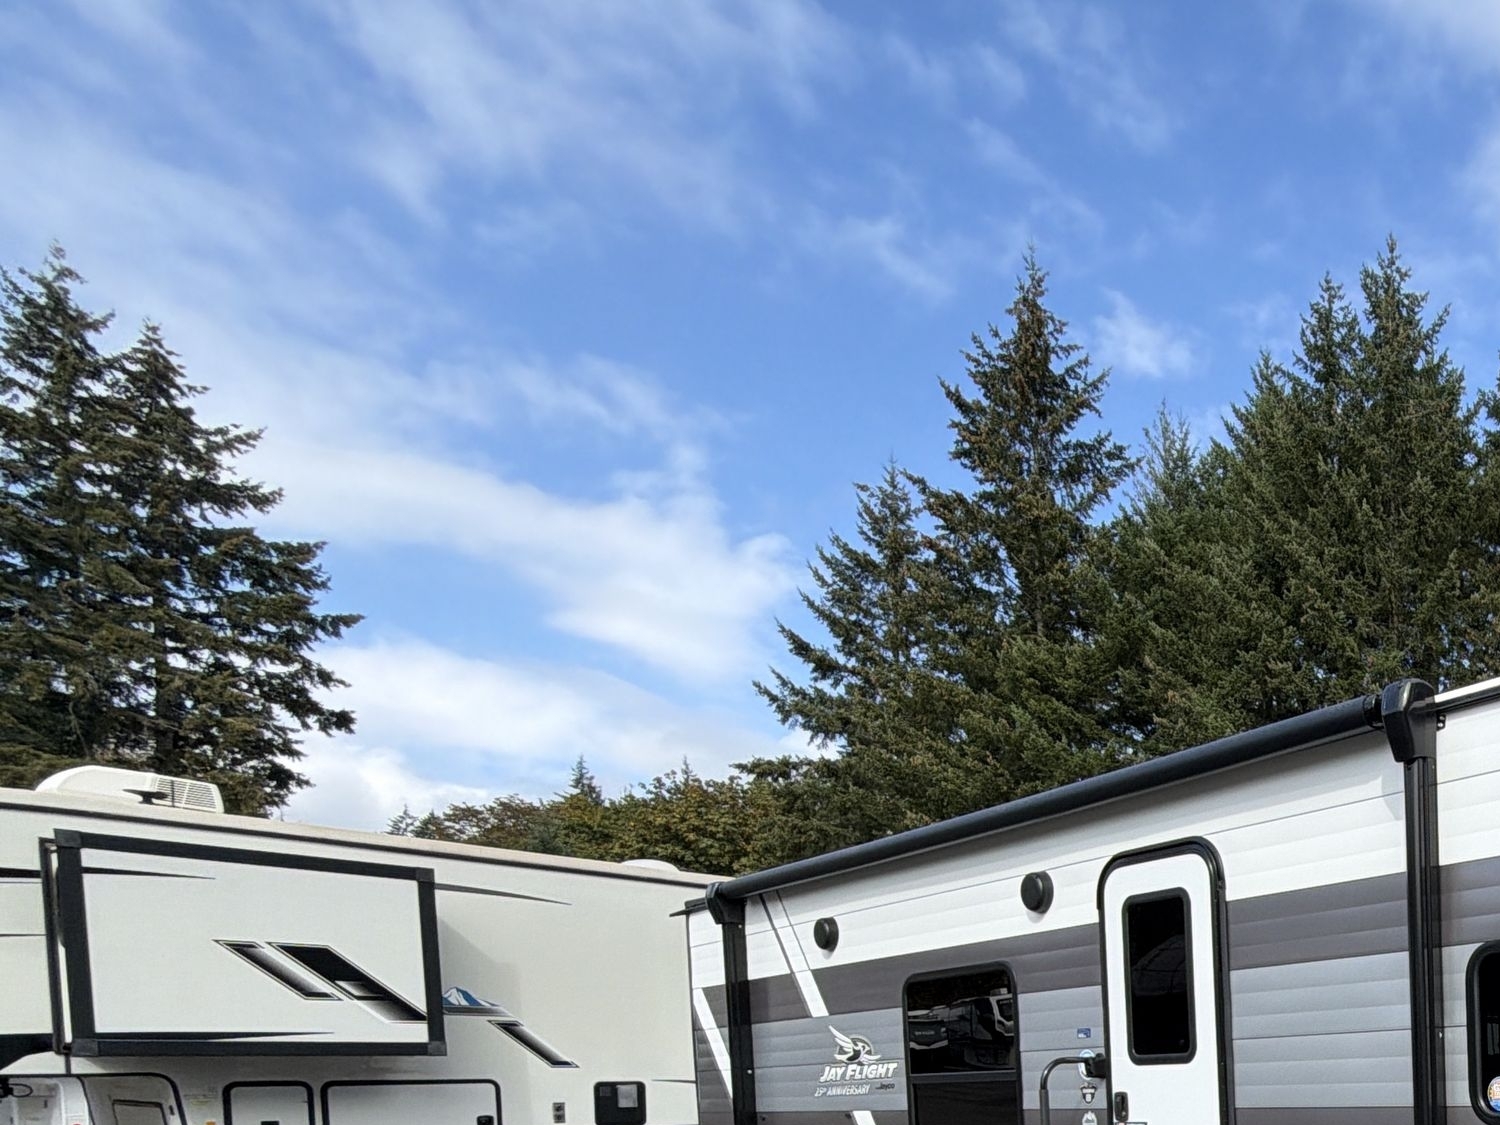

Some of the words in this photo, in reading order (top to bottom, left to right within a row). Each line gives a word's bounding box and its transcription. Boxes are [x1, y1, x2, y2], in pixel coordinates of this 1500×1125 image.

[820, 1066, 846, 1083] JAY
[845, 1062, 898, 1081] FLIGHT
[826, 1084, 871, 1097] ANNIVERSARY
